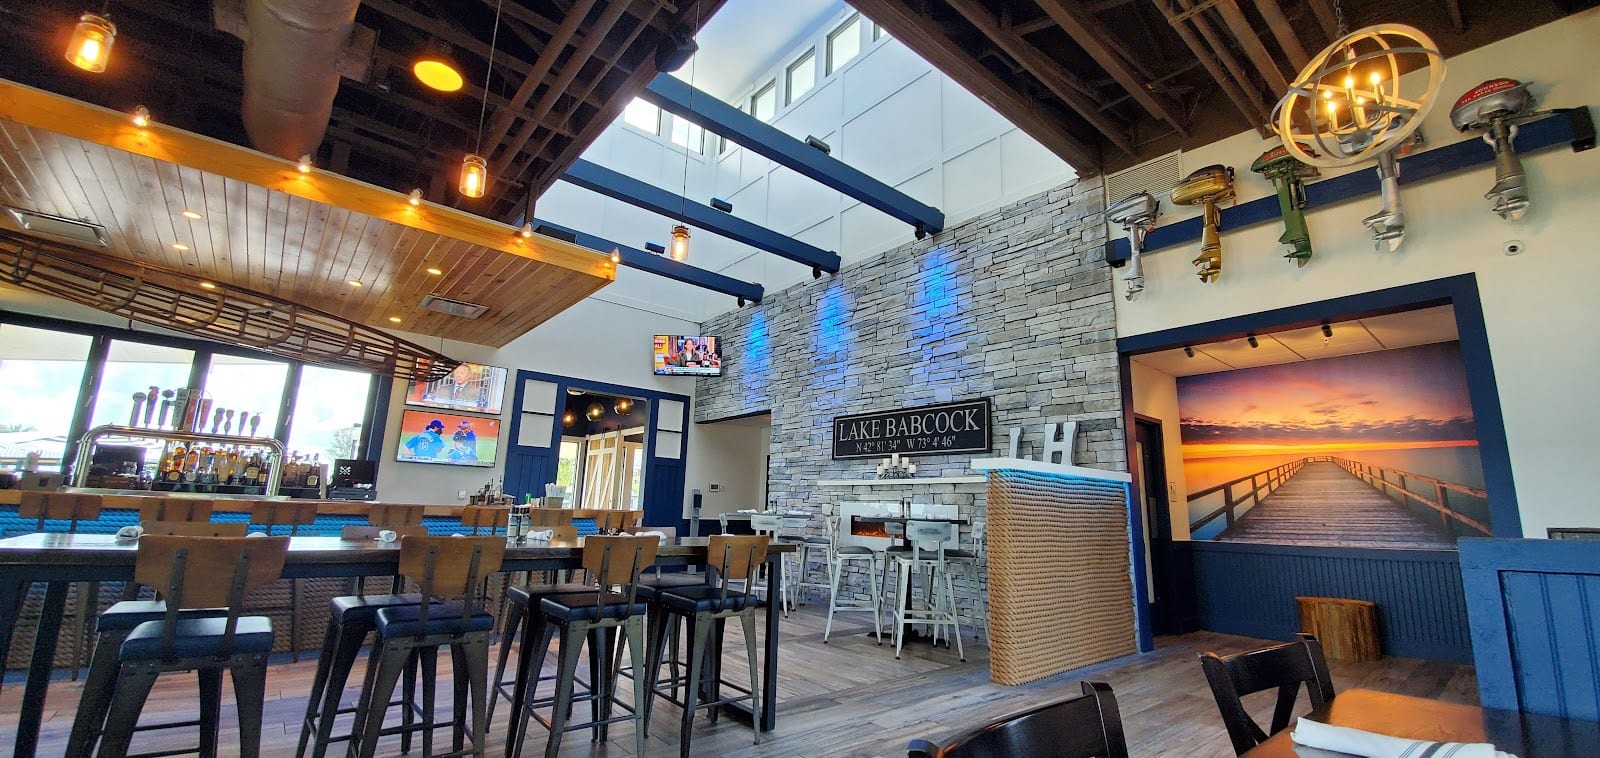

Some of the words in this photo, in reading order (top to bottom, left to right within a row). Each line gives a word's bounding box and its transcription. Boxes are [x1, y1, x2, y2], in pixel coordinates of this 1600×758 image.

[839, 419, 881, 442] LAKE
[885, 408, 981, 438] BABCOCK
[855, 442, 862, 453] N
[863, 441, 875, 452] 42°
[888, 440, 901, 451] 34"
[906, 438, 915, 449] W
[917, 437, 931, 449] 73°
[932, 436, 940, 448] 4'
[941, 435, 956, 448] 46"
